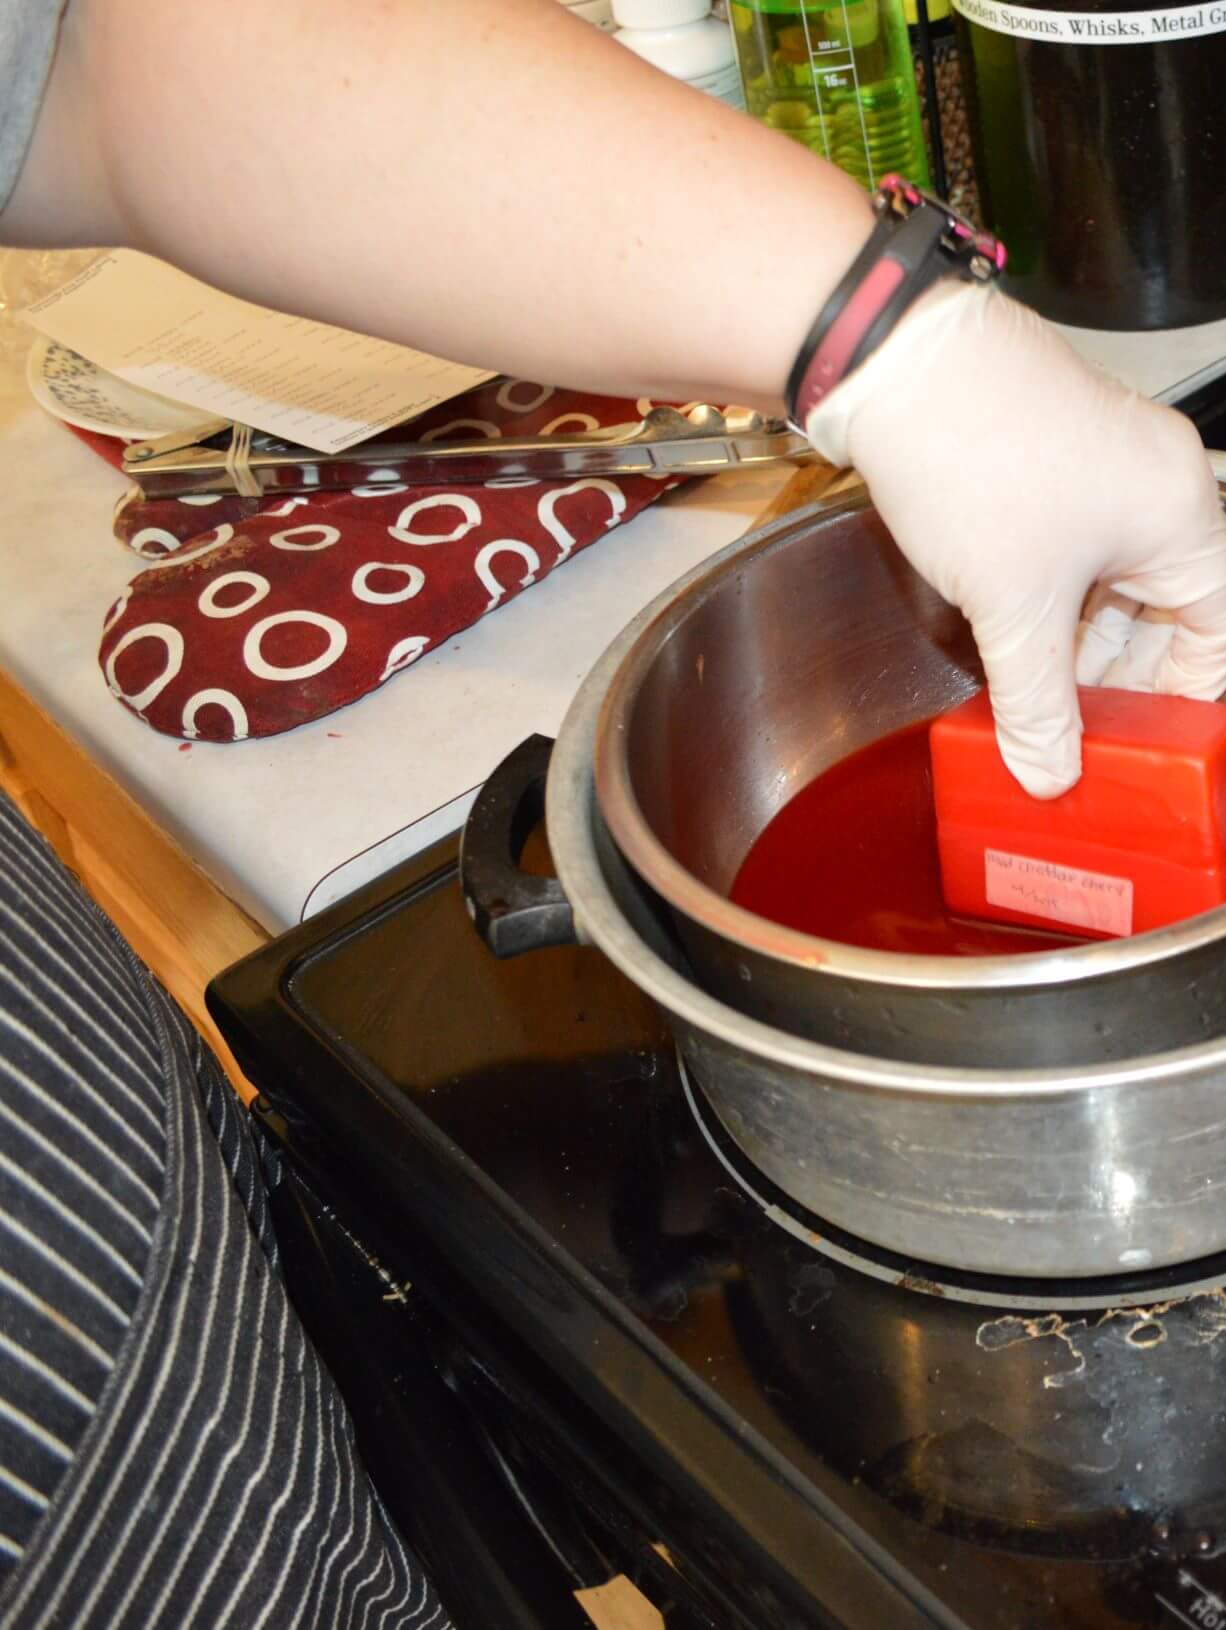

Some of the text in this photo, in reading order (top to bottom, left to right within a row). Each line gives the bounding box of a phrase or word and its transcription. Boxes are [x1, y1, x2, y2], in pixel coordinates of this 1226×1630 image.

[1001, 12, 1063, 36] Spoons,
[1068, 16, 1146, 37] Whisks,
[1151, 10, 1204, 34] Metal
